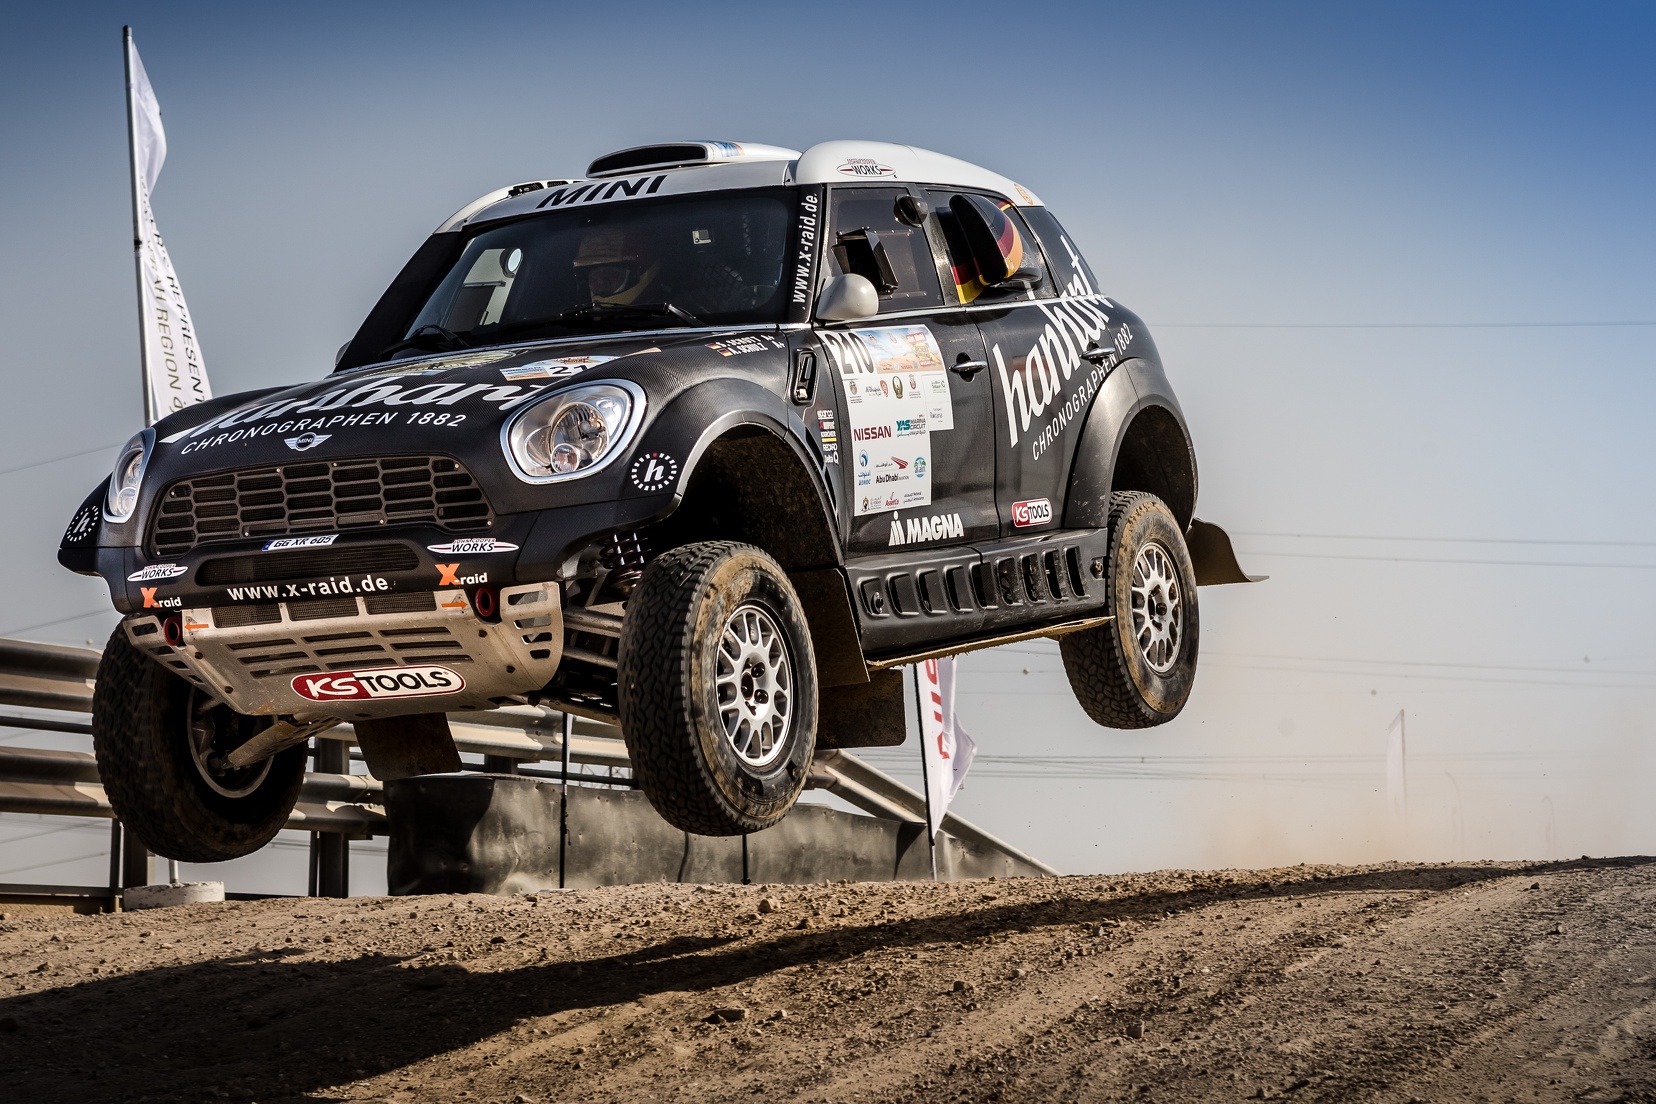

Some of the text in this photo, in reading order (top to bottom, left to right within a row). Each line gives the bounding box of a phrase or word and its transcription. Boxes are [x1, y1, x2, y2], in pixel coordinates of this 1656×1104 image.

[851, 164, 882, 175] WORKS
[535, 174, 668, 209] MINI
[155, 307, 182, 390] REGION
[824, 332, 875, 375] 210
[1032, 322, 1134, 462] CHRONOGRAPHEN 1882
[181, 411, 468, 455] CHRONOGRAPHEN 1882
[853, 425, 892, 441] NISSAN
[896, 420, 911, 431] YAS
[643, 459, 665, 483] h
[875, 475, 886, 484] Abu
[885, 473, 899, 483] Dhabi
[72, 511, 91, 534] h
[906, 512, 965, 544] MAGNA
[291, 538, 309, 546] XR
[309, 536, 334, 545] 605
[451, 543, 495, 552] WORKS
[141, 568, 175, 579] WORKS
[434, 563, 488, 586] X-raid
[140, 586, 182, 608] X-raid
[226, 574, 391, 601] www.x-raid.de
